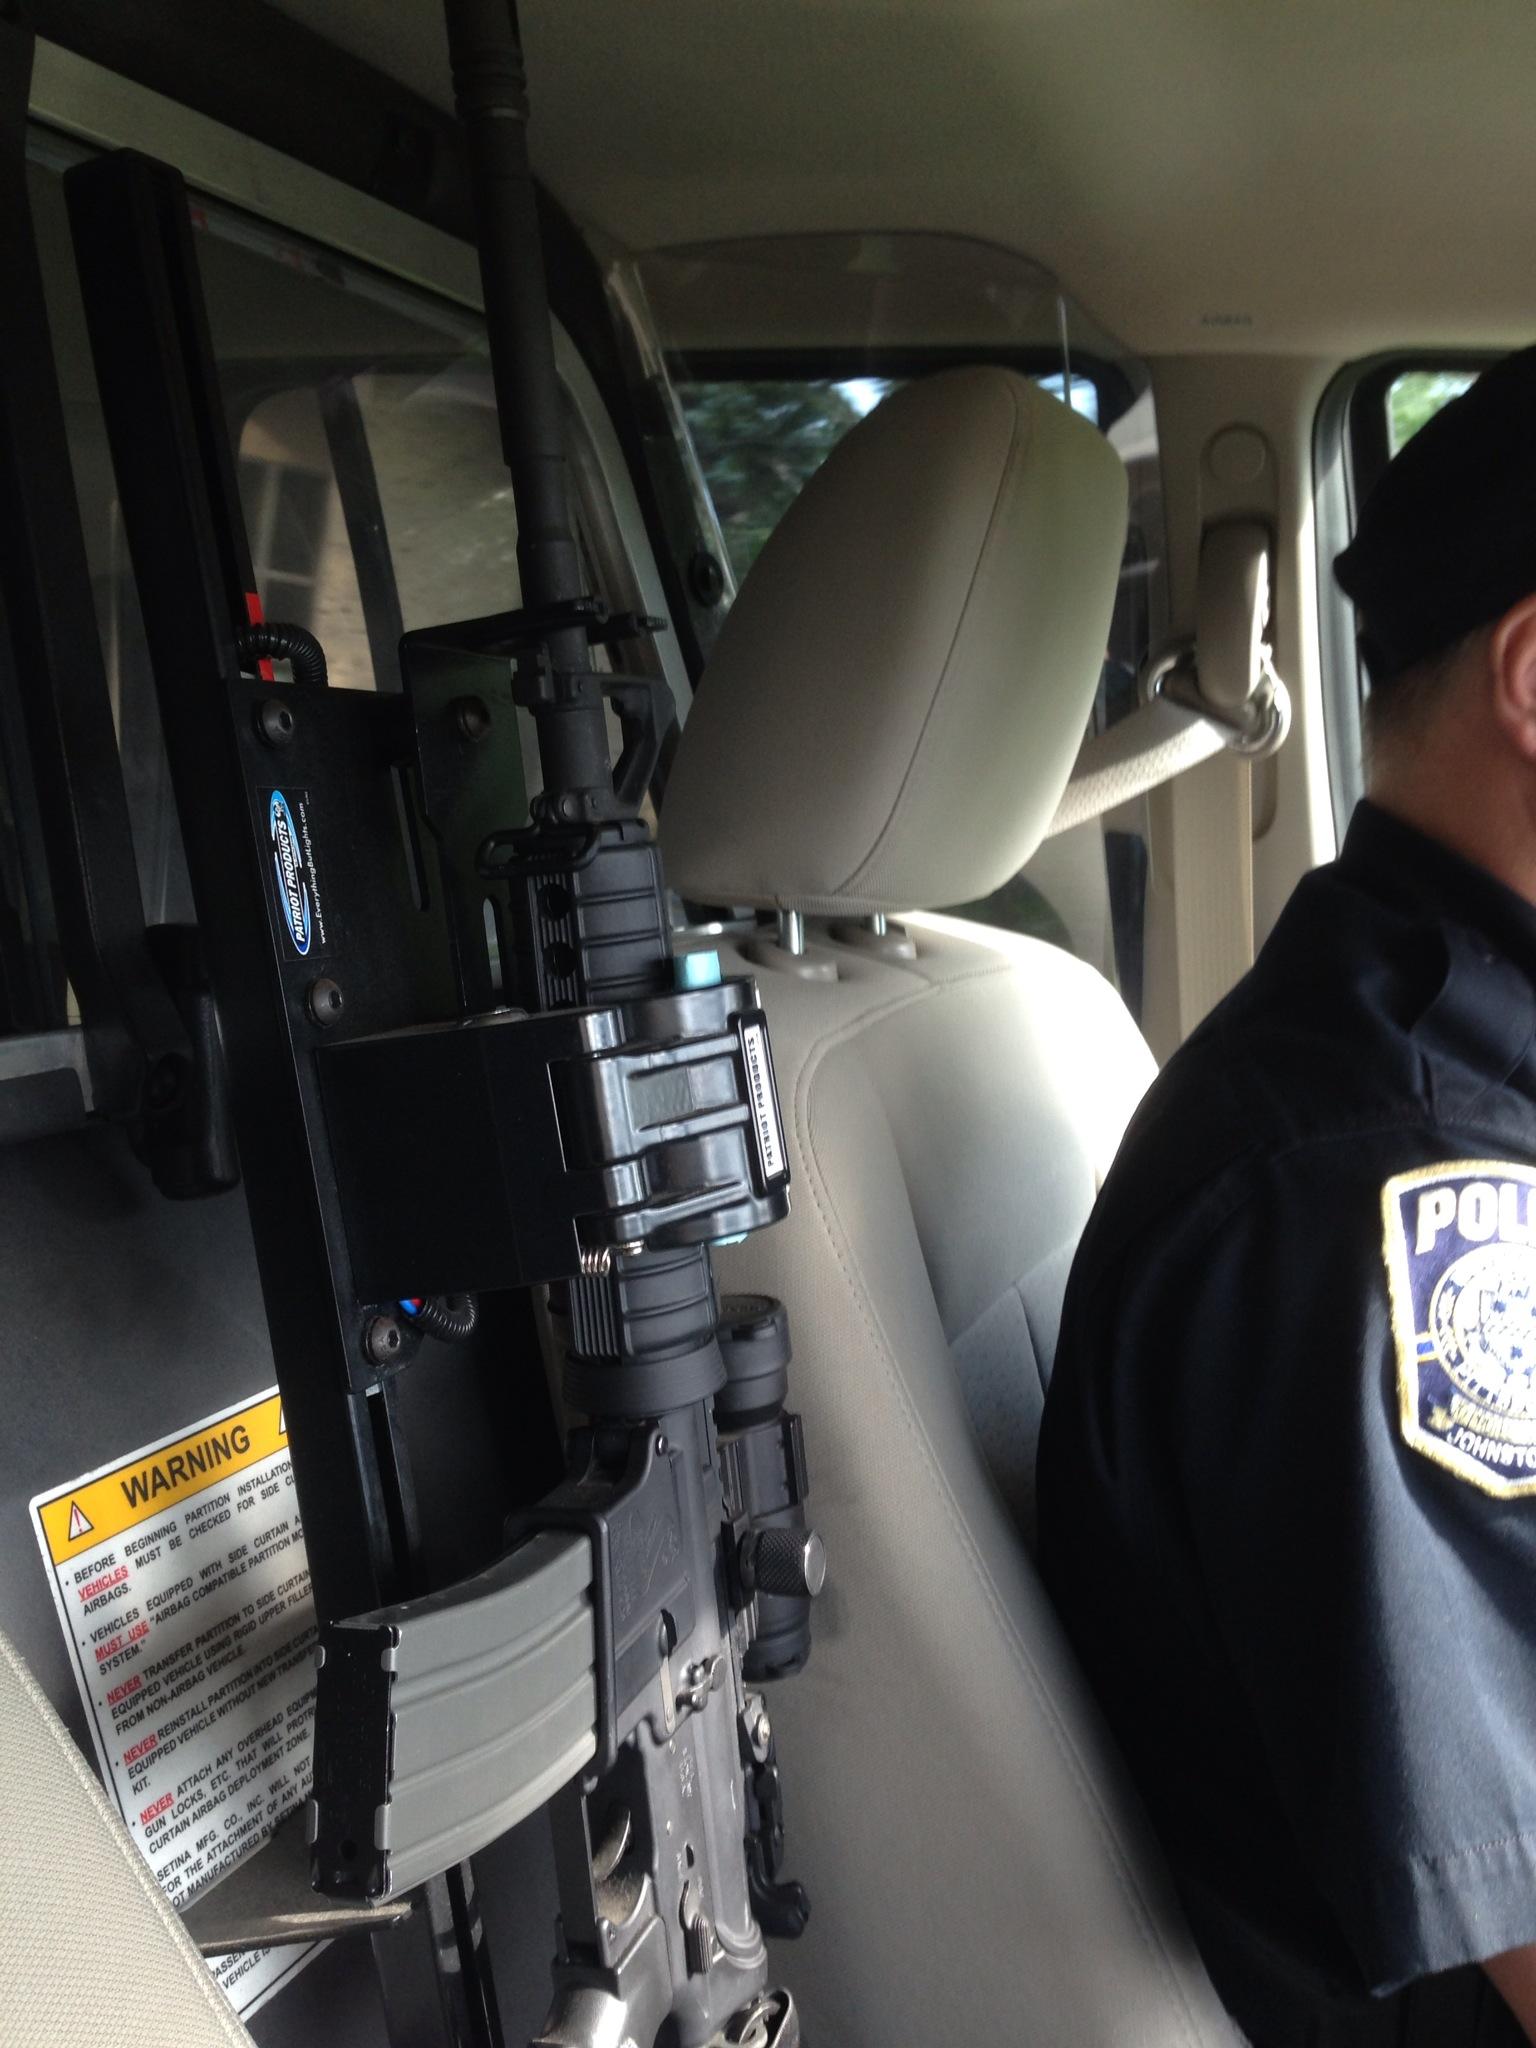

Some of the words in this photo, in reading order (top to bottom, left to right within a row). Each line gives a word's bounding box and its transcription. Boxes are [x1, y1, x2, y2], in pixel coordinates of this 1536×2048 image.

[277, 819, 297, 889] PRODUCTS
[299, 802, 326, 944] www.EverythingButLights.com
[288, 889, 305, 942] PATRIOT
[748, 1037, 765, 1109] PRODUCTS
[760, 1113, 773, 1167] PATRIOT
[120, 1425, 250, 1509] WARNING
[74, 1553, 116, 1584] BEFORE
[124, 1521, 177, 1557] BEGINNING
[184, 1493, 230, 1524] PARTITION
[78, 1565, 129, 1601] VEHICLES
[134, 1547, 162, 1569] MUST
[168, 1535, 183, 1550] BE
[188, 1509, 231, 1540] CHECKED
[237, 1496, 256, 1513] FOR
[260, 1482, 280, 1500] SIDE
[90, 1608, 140, 1643] VEHICLES
[146, 1577, 193, 1611] EQUIPPED
[199, 1560, 222, 1580] WITH
[228, 1545, 249, 1563] SIDE
[253, 1521, 289, 1548] CURTAIN
[84, 1582, 132, 1616] AIRBAGS.
[95, 1638, 124, 1663] MUST
[128, 1621, 150, 1643] USE
[192, 1562, 247, 1601] COMPATIBLE
[248, 1537, 291, 1569] PARTITION
[106, 1674, 142, 1706] NEVER
[142, 1643, 194, 1680] TRANSFER
[195, 1613, 241, 1648] PARTITION
[242, 1604, 255, 1618] TO
[256, 1590, 276, 1610] SIDE
[111, 1683, 161, 1720] EQUIPPED
[163, 1656, 203, 1687] VEHICLE
[204, 1635, 232, 1660] USING
[233, 1620, 257, 1640] RIGID
[258, 1601, 286, 1624] UPPER
[115, 1710, 145, 1736] FROM
[147, 1672, 205, 1717] NON-AIRBAG
[123, 1734, 158, 1767] NEVER
[157, 1703, 208, 1741] REINSTALL
[208, 1669, 253, 1707] PARTITION
[128, 1741, 177, 1780] EQUIPPED
[177, 1712, 217, 1745] VEHICLE
[216, 1683, 255, 1721] WITHOUT
[132, 1777, 150, 1795] KIT.
[139, 1791, 175, 1825] NEVER
[177, 1764, 213, 1797] ATTACH
[216, 1745, 234, 1768] ANY
[237, 1712, 283, 1752] OVERHEAD
[144, 1816, 167, 1838] GUN
[210, 1770, 232, 1792] ETC.
[235, 1748, 257, 1773] THAT
[262, 1731, 283, 1752] WILL
[150, 1817, 190, 1854] CURTAIN
[192, 1791, 227, 1824] AIRBAG
[228, 1746, 284, 1796] DEPLOYMENT
[157, 1850, 191, 1881] SETINA
[196, 1830, 219, 1852] MFG.
[247, 1794, 265, 1813] INC.
[268, 1775, 290, 1795] WILL
[293, 1756, 310, 1776] NOT
[184, 1858, 204, 1879] THE
[207, 1811, 264, 1863] ATTACHMENT
[267, 1799, 278, 1815] OF
[282, 1783, 298, 1804] ANY
[187, 1832, 260, 1897] MANUFACTURED
[261, 1821, 272, 1838] BY
[222, 1950, 261, 1989] VEHICLE
